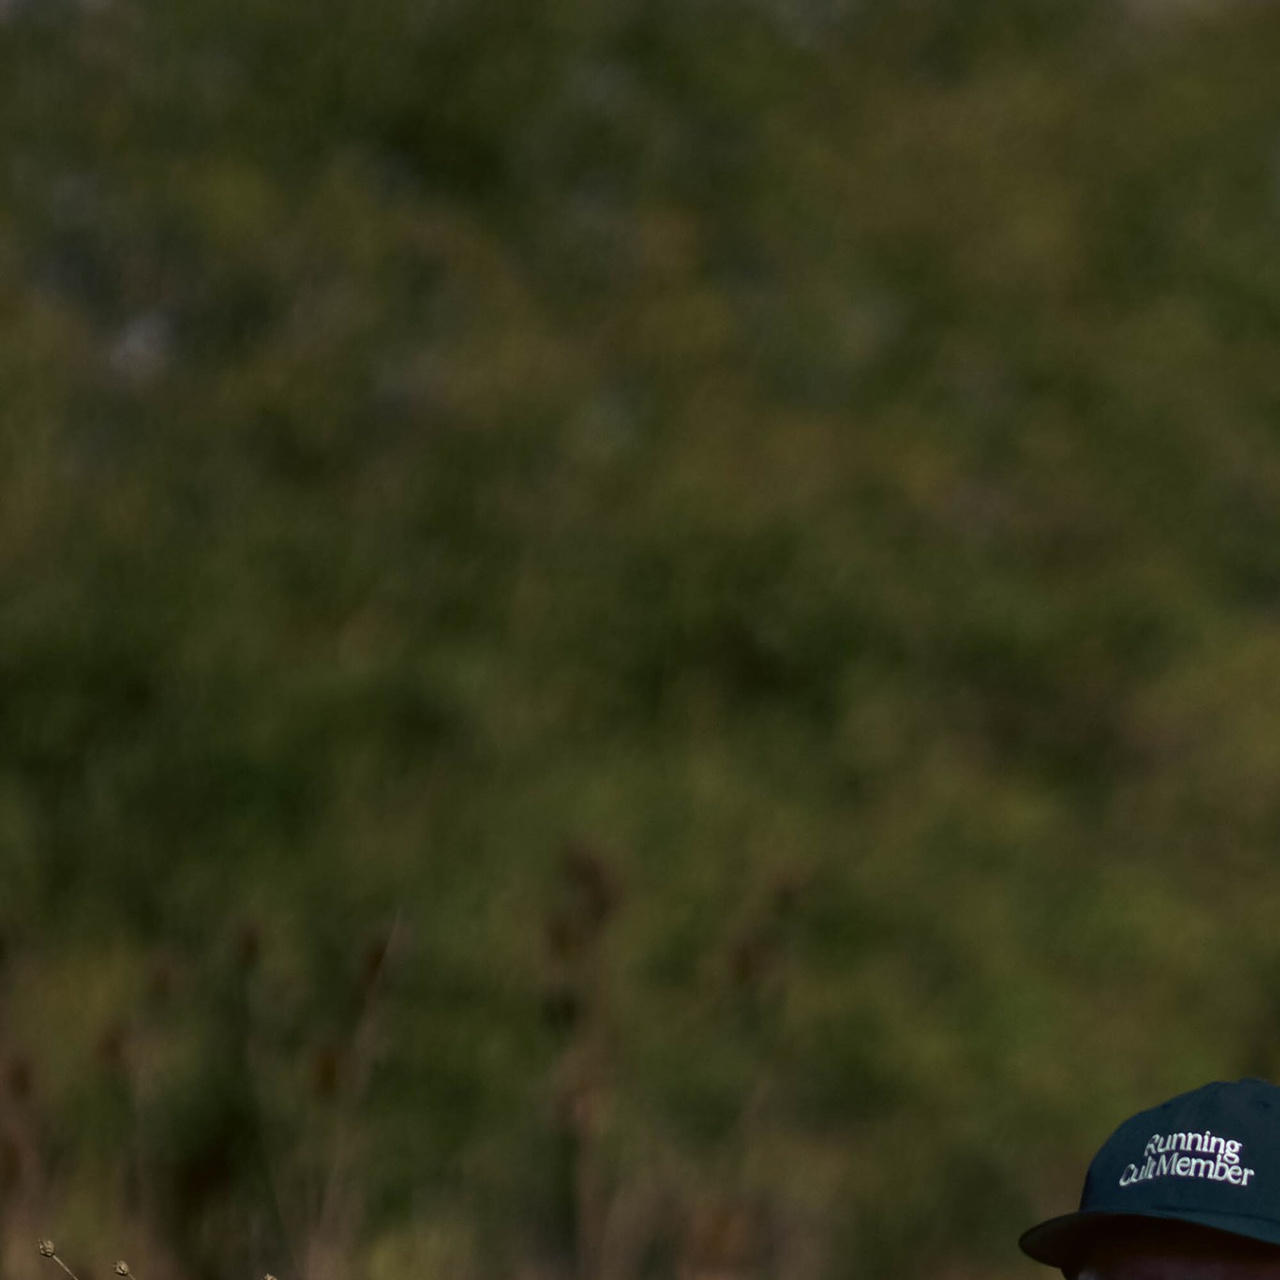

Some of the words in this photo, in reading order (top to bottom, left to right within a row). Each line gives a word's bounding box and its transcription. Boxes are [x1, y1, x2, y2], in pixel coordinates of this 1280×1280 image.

[1144, 1131, 1243, 1164] Running
[1119, 1156, 1157, 1186] Cult
[1155, 1152, 1255, 1186] Member
